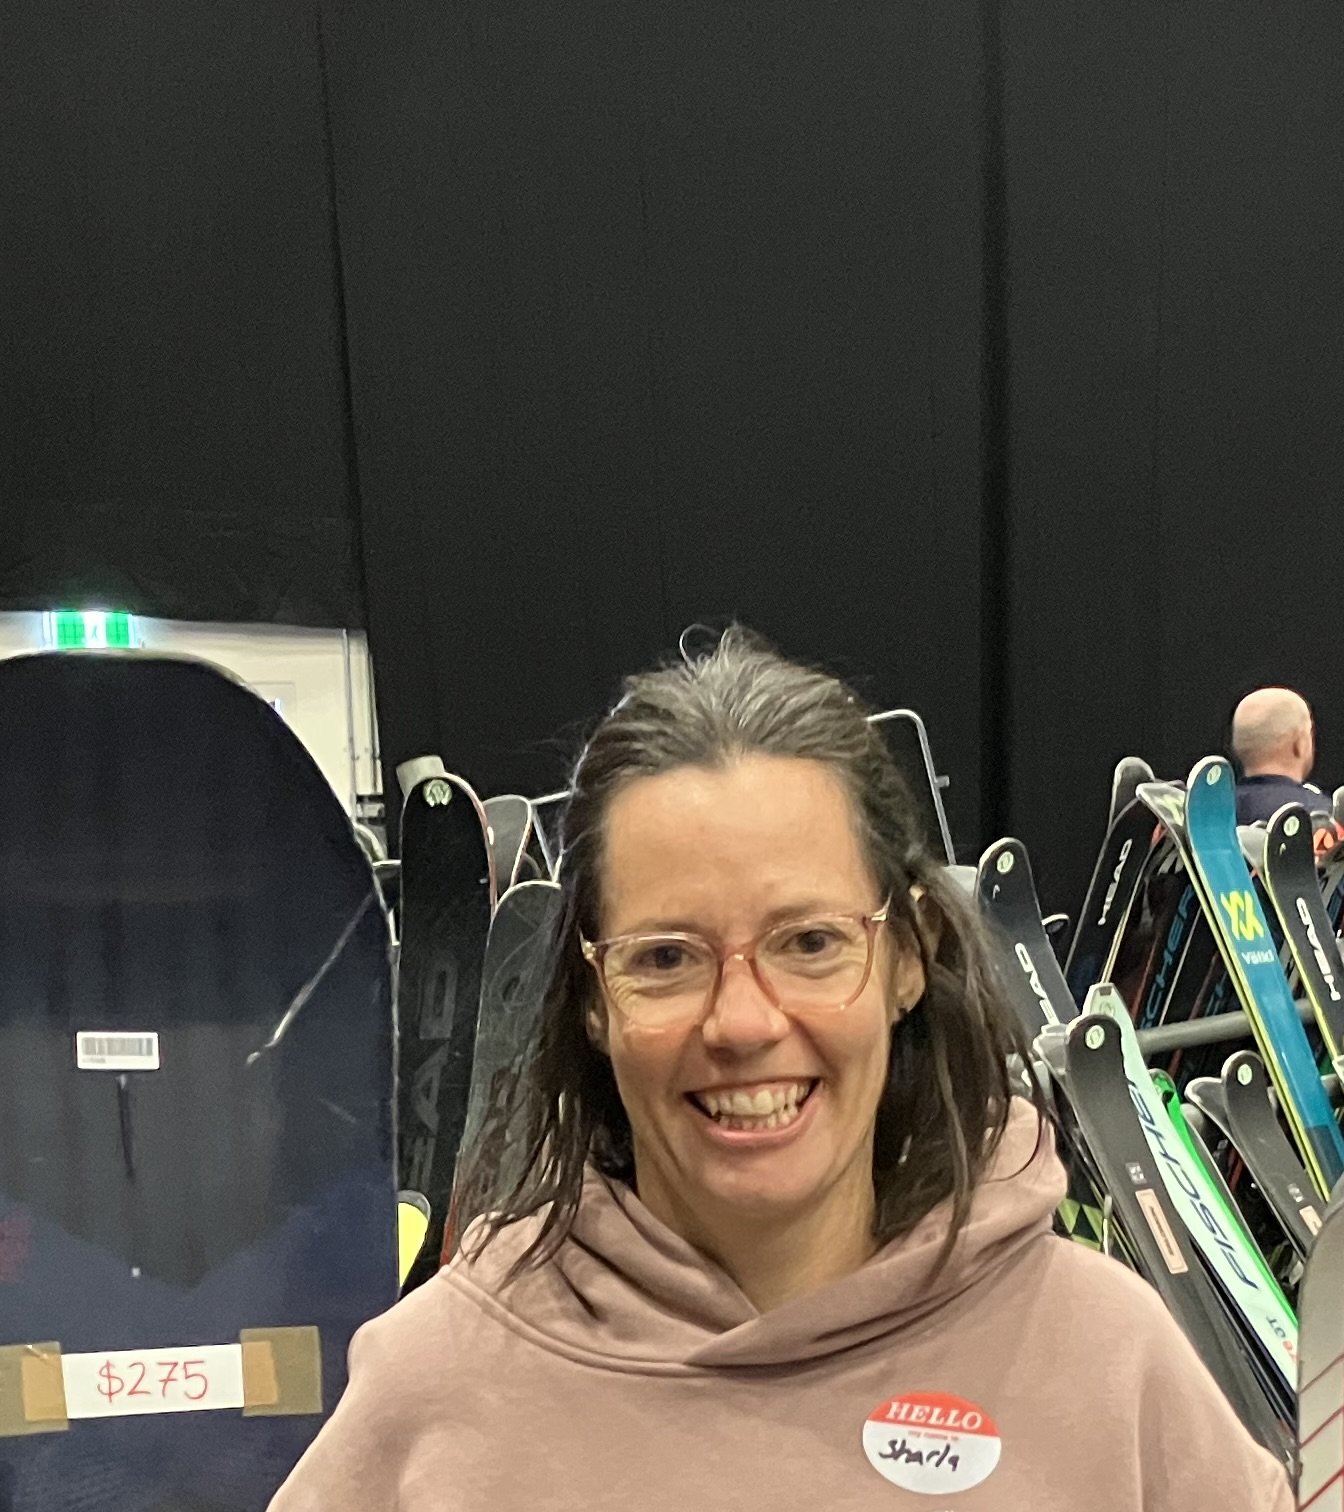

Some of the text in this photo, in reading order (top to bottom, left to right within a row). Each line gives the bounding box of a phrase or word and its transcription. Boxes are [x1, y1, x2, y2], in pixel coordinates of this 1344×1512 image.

[1014, 942, 1061, 1025] EAD
[1296, 897, 1342, 1002] HEAD
[1127, 1076, 1260, 1290] FISCHE
[96, 1359, 209, 1404] $275
[885, 1401, 983, 1431] HELLO
